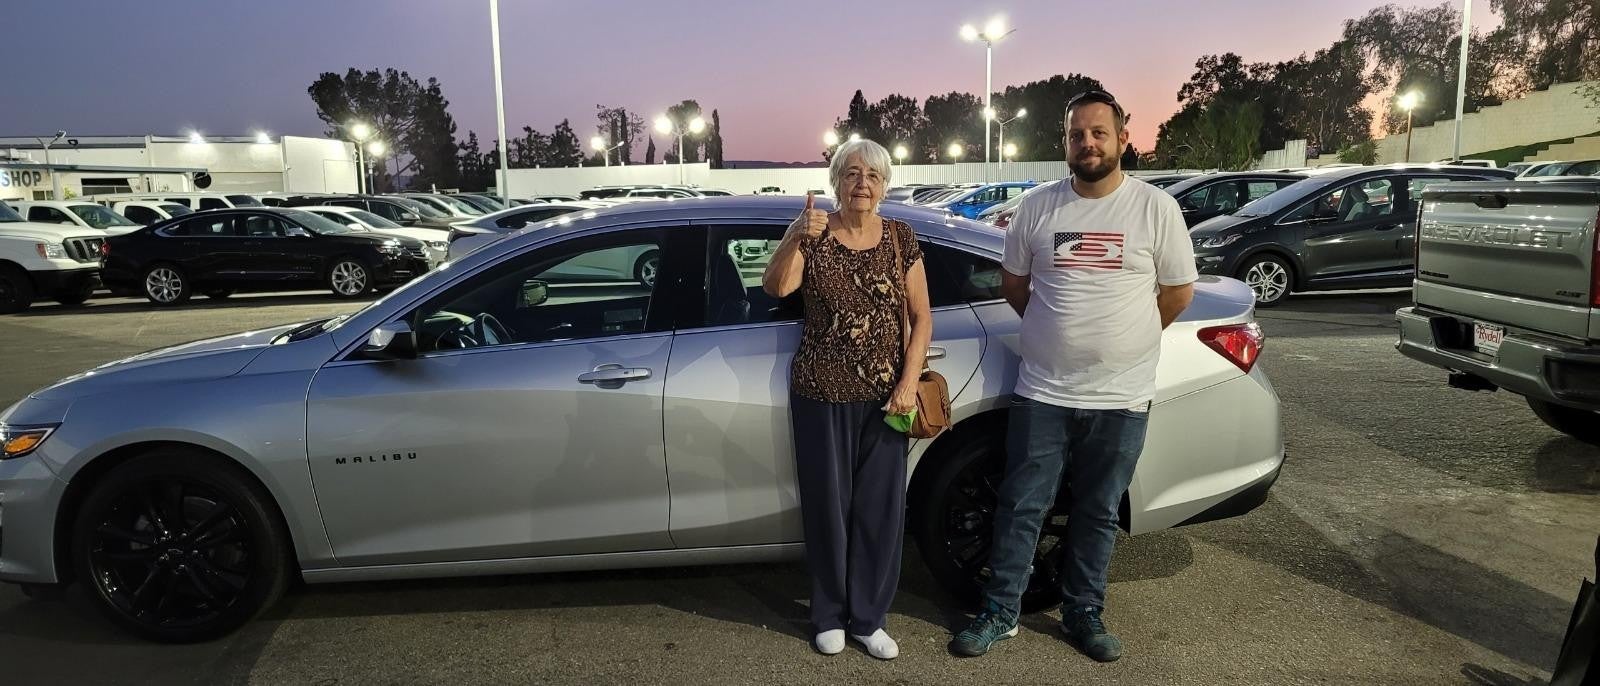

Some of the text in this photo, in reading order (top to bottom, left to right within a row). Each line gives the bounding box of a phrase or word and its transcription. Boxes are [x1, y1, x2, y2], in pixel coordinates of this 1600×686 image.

[1, 170, 42, 187] SHOP
[1422, 223, 1572, 249] CHEVROLET
[1476, 327, 1501, 344] Rydell
[335, 452, 417, 465] MALIBU
